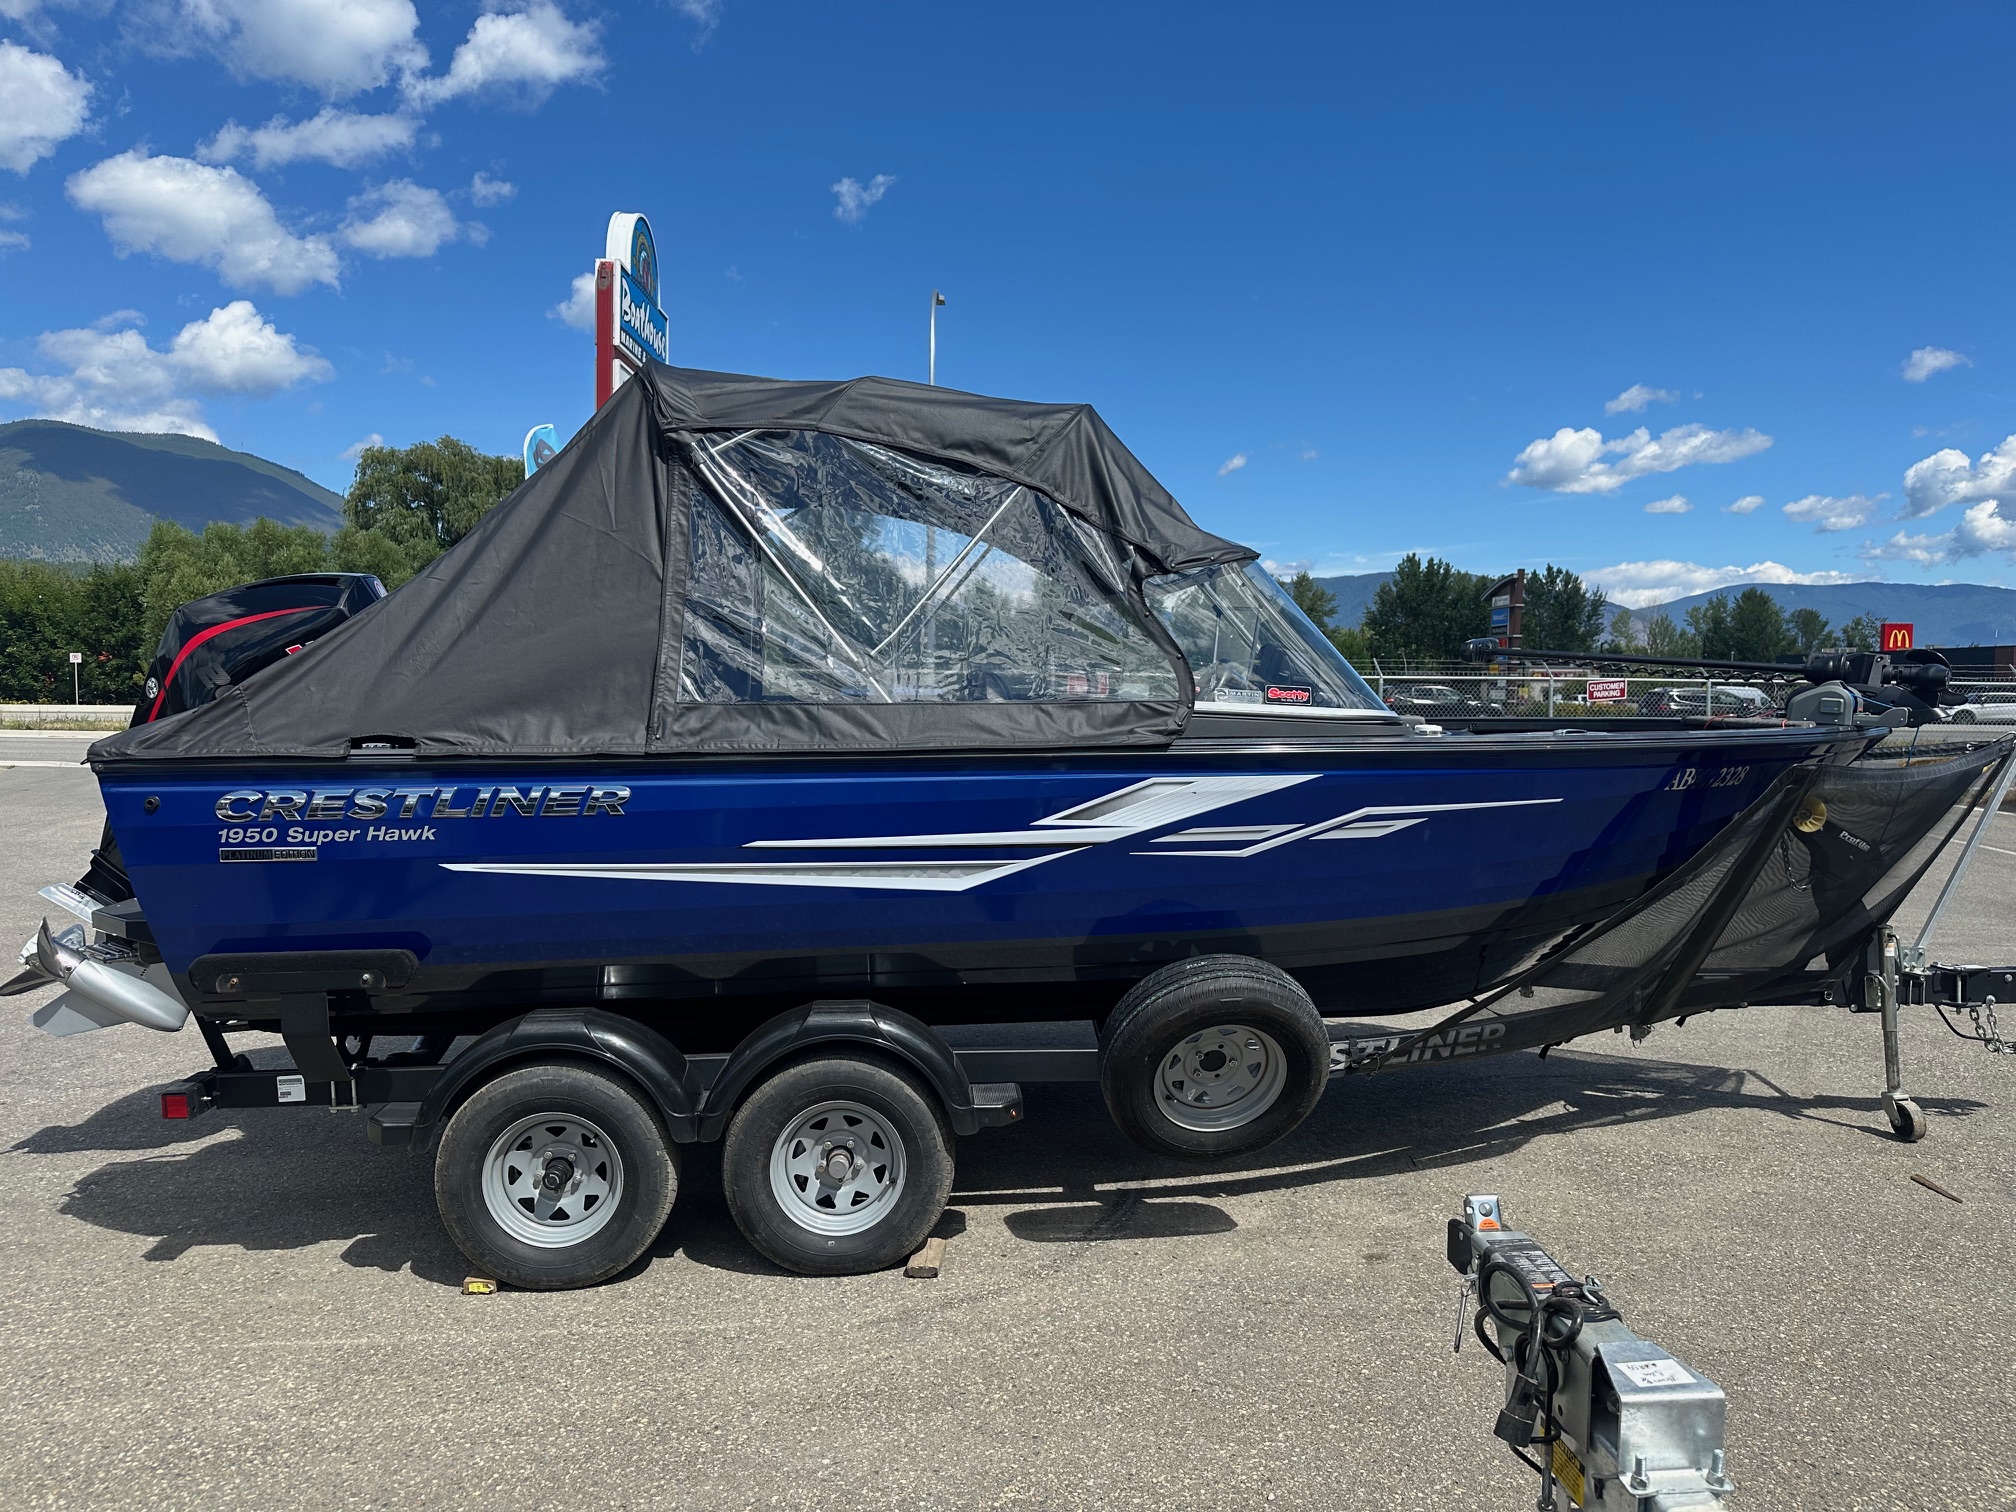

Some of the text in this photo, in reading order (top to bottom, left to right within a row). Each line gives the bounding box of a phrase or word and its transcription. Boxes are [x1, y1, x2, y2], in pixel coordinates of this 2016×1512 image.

[621, 276, 666, 360] Boathouse
[620, 329, 642, 360] MARINE
[1267, 687, 1309, 702] Scotty
[1589, 682, 1625, 691] CUSTOMER
[1593, 690, 1621, 698] PARKING
[214, 785, 632, 823] CRESTLINER
[218, 825, 438, 846] 1950 Super Hawk
[221, 850, 273, 860] PLATINUM
[1553, 1438, 1580, 1470] AUTION
